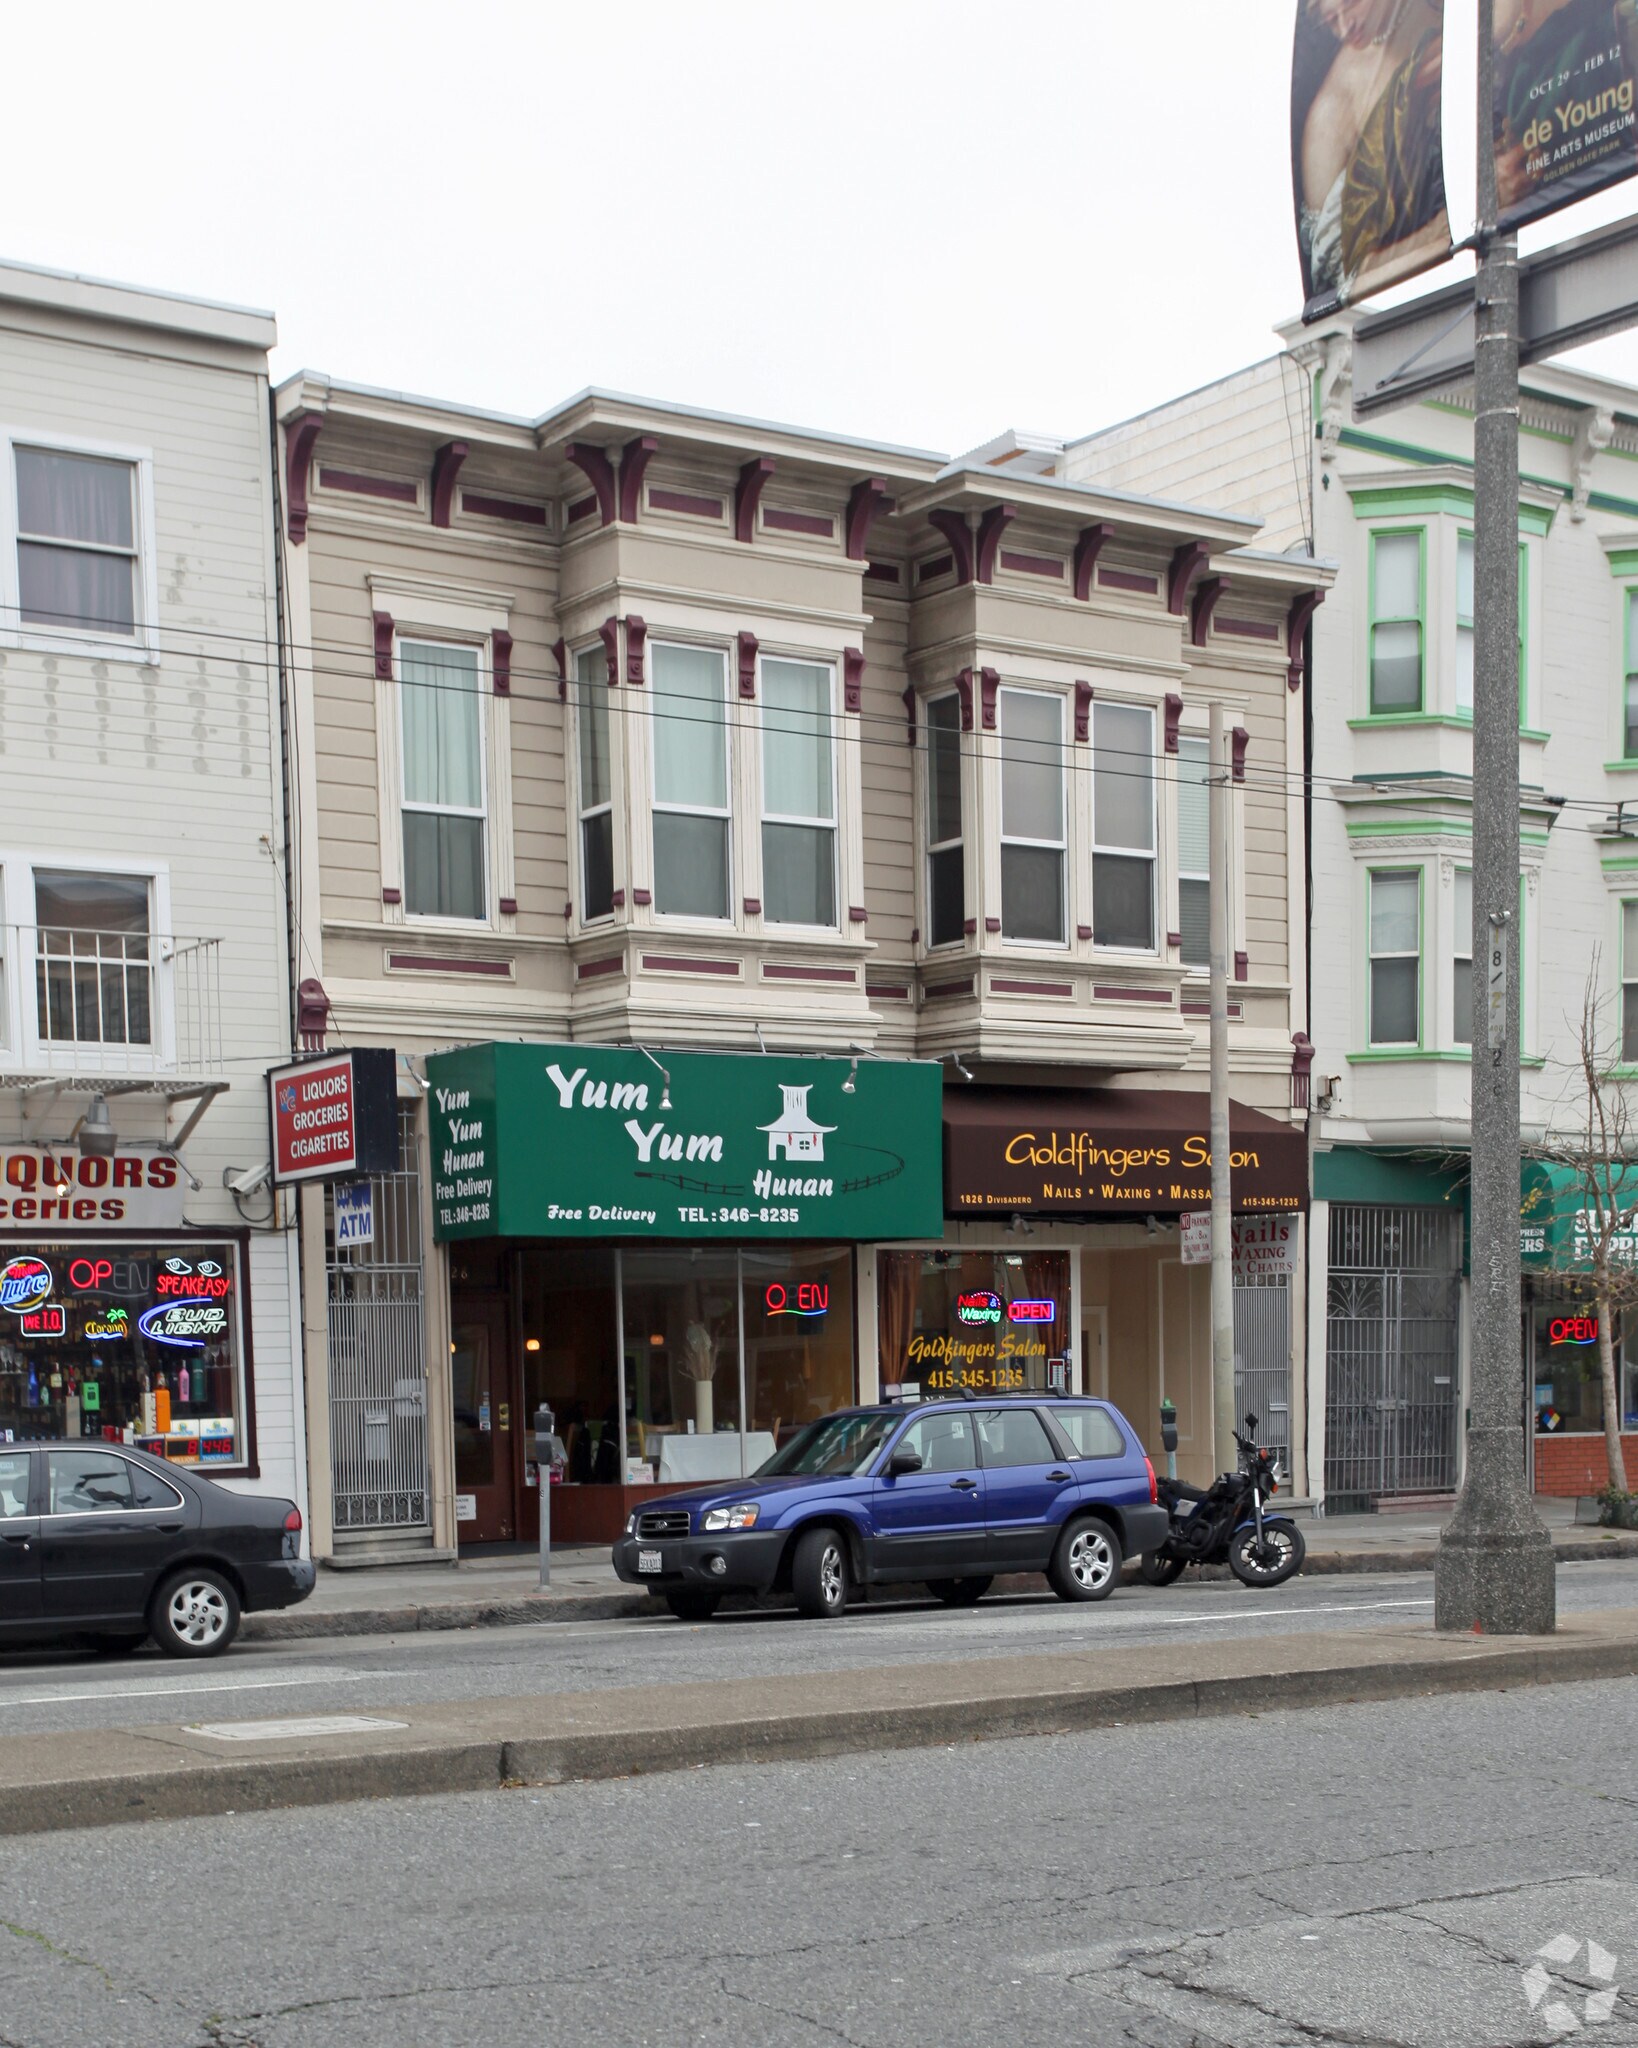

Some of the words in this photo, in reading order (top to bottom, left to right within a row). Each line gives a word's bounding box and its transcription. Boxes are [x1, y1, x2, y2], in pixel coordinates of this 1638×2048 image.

[1529, 78, 1553, 100] OCT
[1557, 70, 1570, 87] 29
[1584, 53, 1604, 73] FEB
[1609, 45, 1621, 61] 12
[1522, 118, 1553, 151] de
[1555, 79, 1633, 133] Young
[1526, 152, 1551, 175] FINE
[1553, 138, 1582, 162] ARTS
[1584, 111, 1636, 146] MUSEUM
[1543, 162, 1575, 182] GOLDEN
[1599, 139, 1620, 156] PARK
[302, 1074, 348, 1102] LIQUORS
[546, 1064, 649, 1111] Yum
[435, 1088, 470, 1114] Yum
[293, 1102, 349, 1131] GROCERIES
[448, 1118, 483, 1144] Yum
[624, 1119, 723, 1162] Yum
[290, 1130, 350, 1159] CIGARETTES
[1005, 1131, 1171, 1176] Goldfingers
[1181, 1136, 1259, 1168] Son
[0, 1154, 178, 1193] QUORS
[443, 1149, 484, 1176] Hunan
[436, 1182, 455, 1200] Free
[456, 1178, 492, 1199] Delivery
[753, 1169, 833, 1200] Hunan
[960, 1194, 983, 1204] 1826
[1242, 1197, 1299, 1207] 415-345-1235
[339, 1212, 371, 1239] ATM
[547, 1205, 583, 1220] Free
[588, 1206, 657, 1224] Delivery
[1231, 1220, 1290, 1244] Nails
[1520, 1228, 1545, 1237] PRESS
[69, 1257, 150, 1291] OPEN
[156, 1274, 230, 1297] SPEAKEASY
[957, 1294, 988, 1308] Nails
[989, 1298, 997, 1308] &
[1007, 1303, 1051, 1321] OPEN
[23, 1314, 41, 1331] WE
[165, 1307, 225, 1322] BUD
[961, 1306, 1002, 1323] Waxing
[84, 1321, 125, 1335] Corona
[149, 1321, 227, 1336] LIGHT
[1549, 1318, 1599, 1340] OPEN
[907, 1335, 996, 1366] Goldfingers
[996, 1333, 1047, 1361] Salon
[927, 1369, 1024, 1388] 415-345-1235
